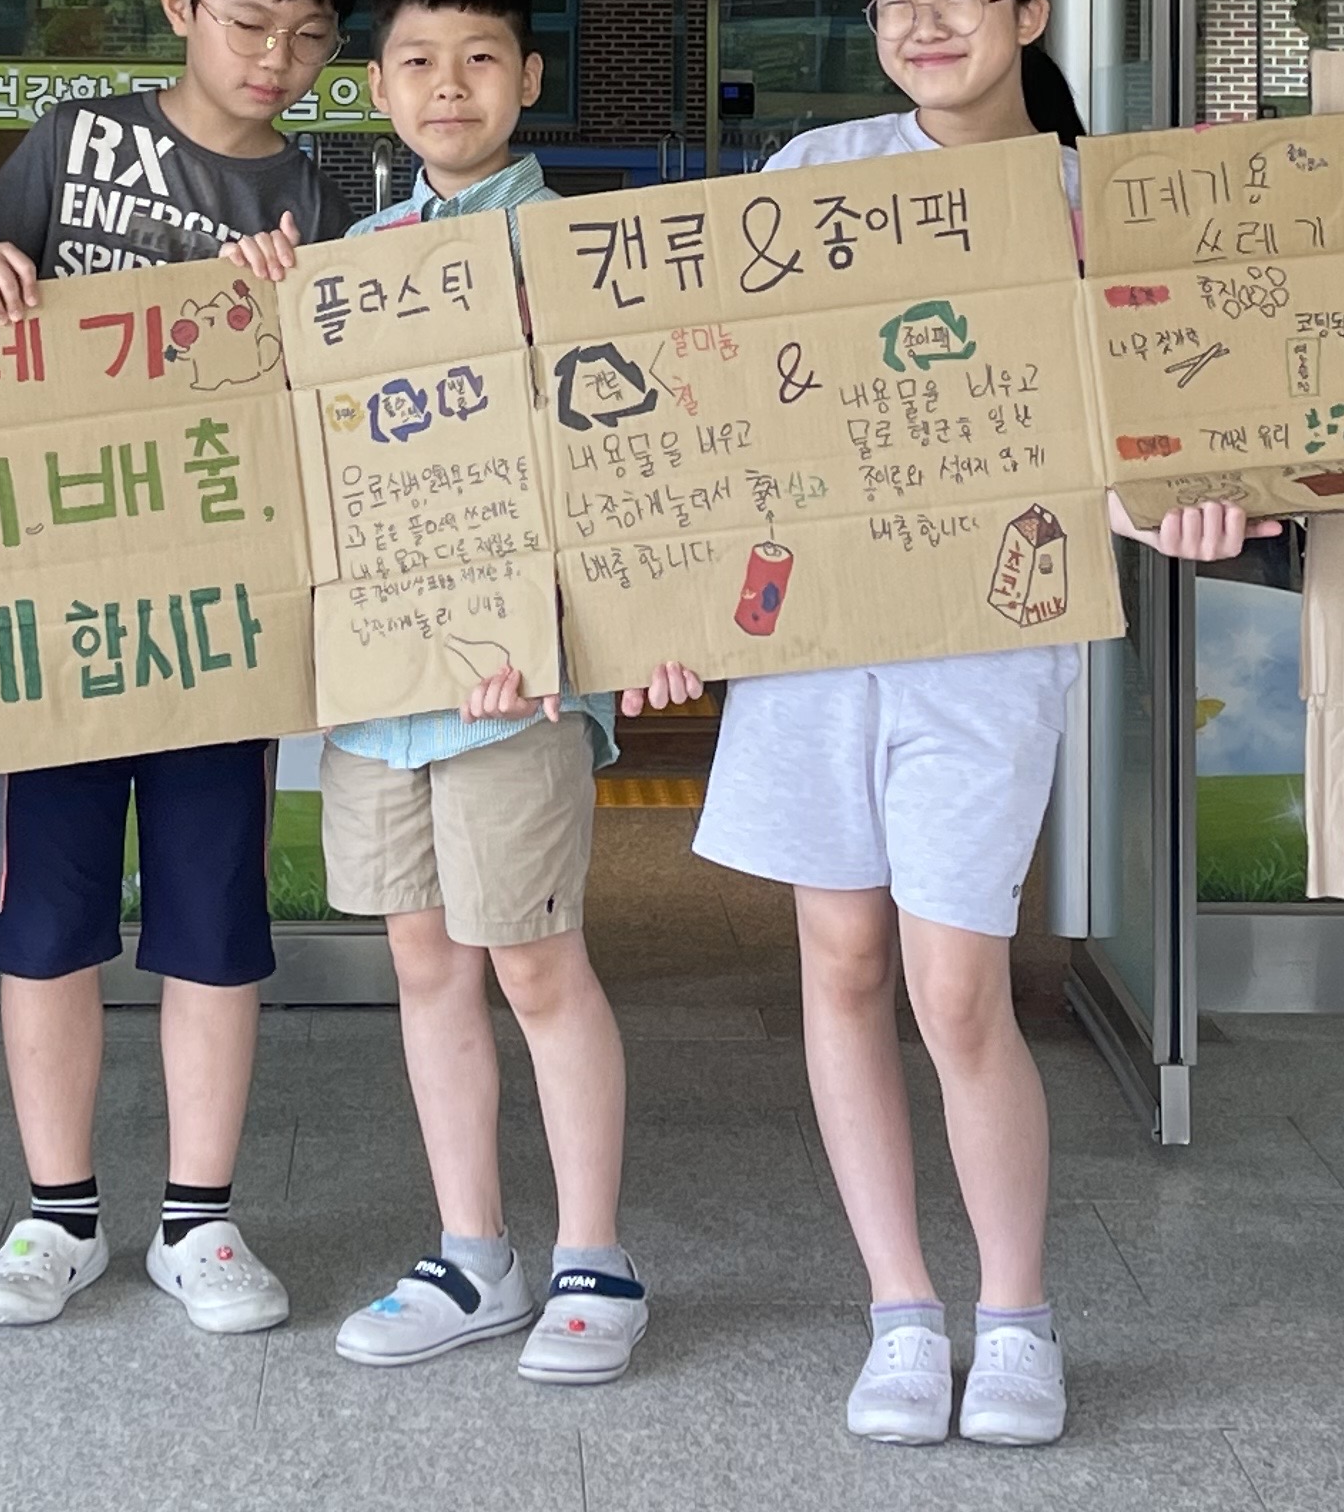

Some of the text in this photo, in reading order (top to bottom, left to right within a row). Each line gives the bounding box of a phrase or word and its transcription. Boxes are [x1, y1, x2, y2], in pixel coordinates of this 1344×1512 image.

[66, 109, 175, 195] RX
[569, 187, 972, 309] 캔류 & 종이팩
[1192, 217, 1326, 264] 쓰레기
[313, 260, 474, 346] 플라스틱
[671, 324, 739, 361] 알미늄
[902, 326, 950, 358] 종이팩
[777, 342, 823, 404] &
[839, 364, 1039, 419] 내용물을 비우고
[568, 432, 682, 478] 내용물을
[1257, 423, 1289, 449] 유리
[1025, 595, 1063, 625] MILK
[66, 583, 262, 700] 합시다
[559, 1276, 596, 1289] RYAN
